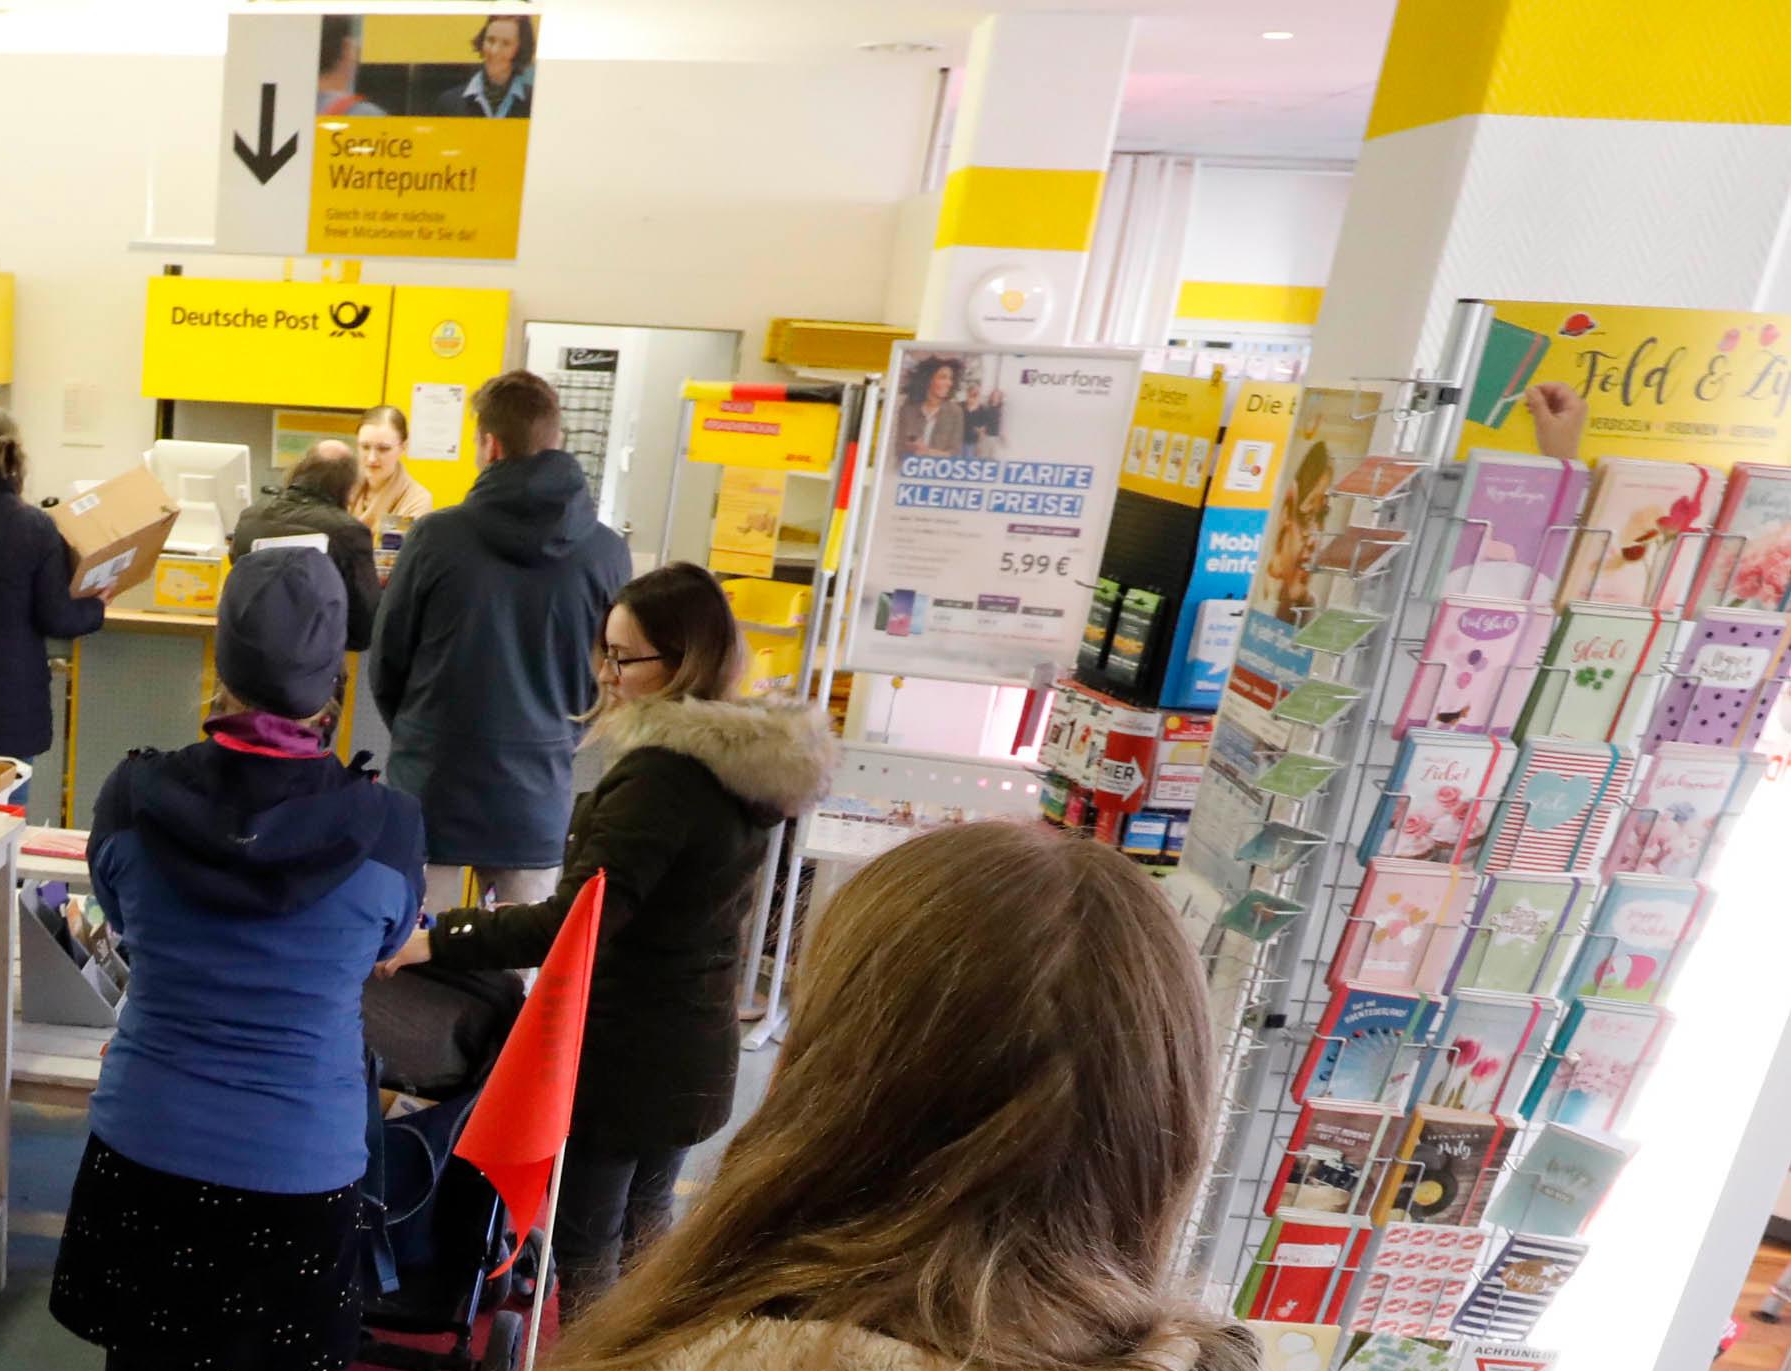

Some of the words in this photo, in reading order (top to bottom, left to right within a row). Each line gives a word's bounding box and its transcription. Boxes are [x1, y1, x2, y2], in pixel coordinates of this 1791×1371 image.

[330, 131, 413, 158] Service
[328, 163, 477, 199] Wartepunkt!
[170, 306, 268, 329] Deutsche
[273, 311, 320, 331] Post
[1246, 393, 1283, 416] Die
[901, 457, 997, 482] GROSSE
[1006, 463, 1092, 488] TARIFE
[897, 484, 982, 509] KLEINE
[987, 491, 1082, 517] PREISE!
[1000, 552, 1051, 575] 5,99
[1055, 556, 1072, 577] €
